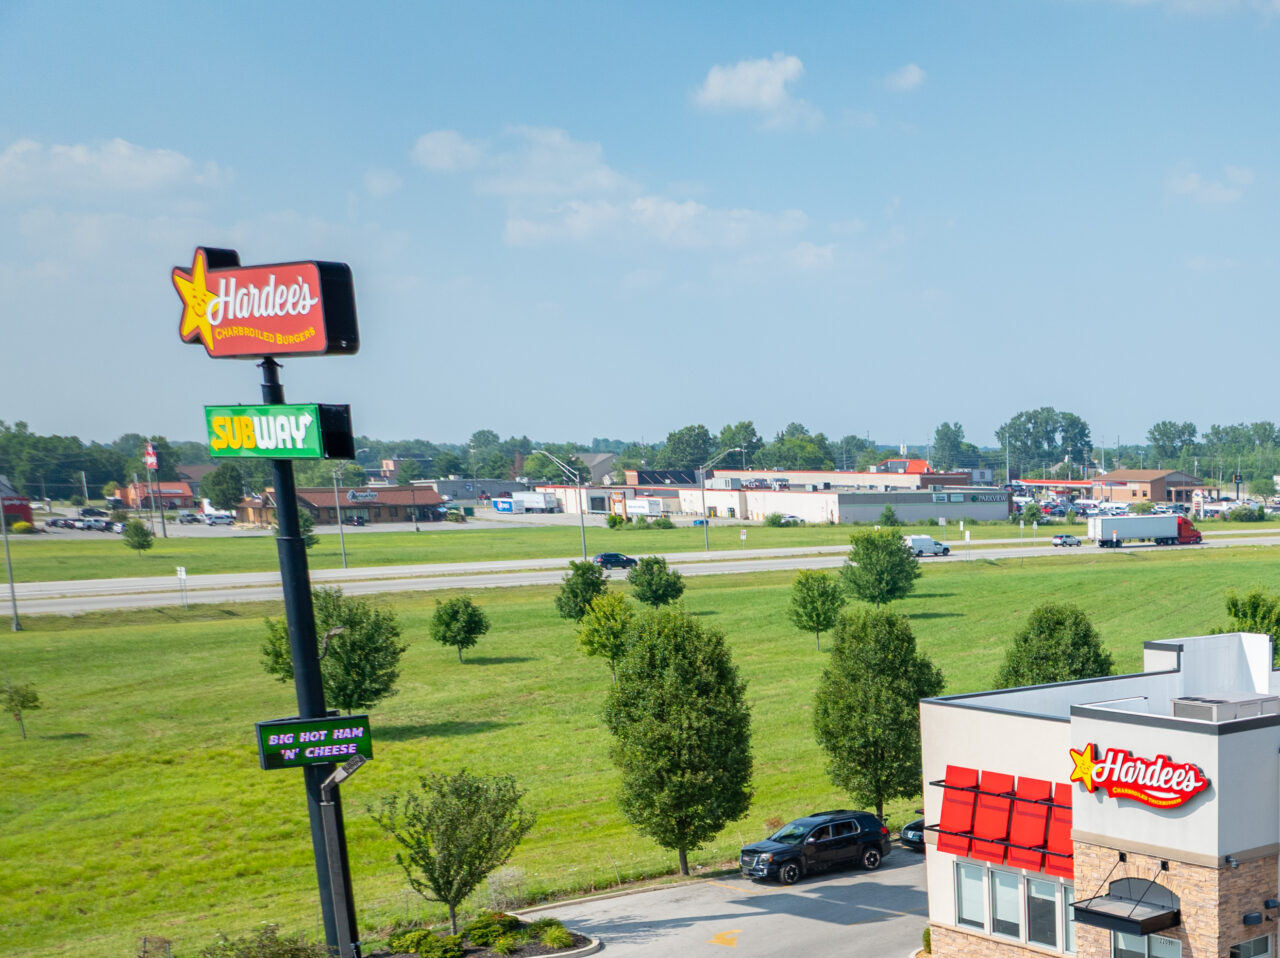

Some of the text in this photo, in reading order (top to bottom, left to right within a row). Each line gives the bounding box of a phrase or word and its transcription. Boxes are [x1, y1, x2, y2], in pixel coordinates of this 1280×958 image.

[206, 274, 318, 326] Hardee's
[215, 326, 316, 345] CHARBROILED BURGERS
[211, 412, 313, 451] SUBWAY
[268, 727, 364, 746] BIG HOT HAM
[281, 743, 358, 760] 'N' CHEESE
[1091, 751, 1204, 792] Hardee's
